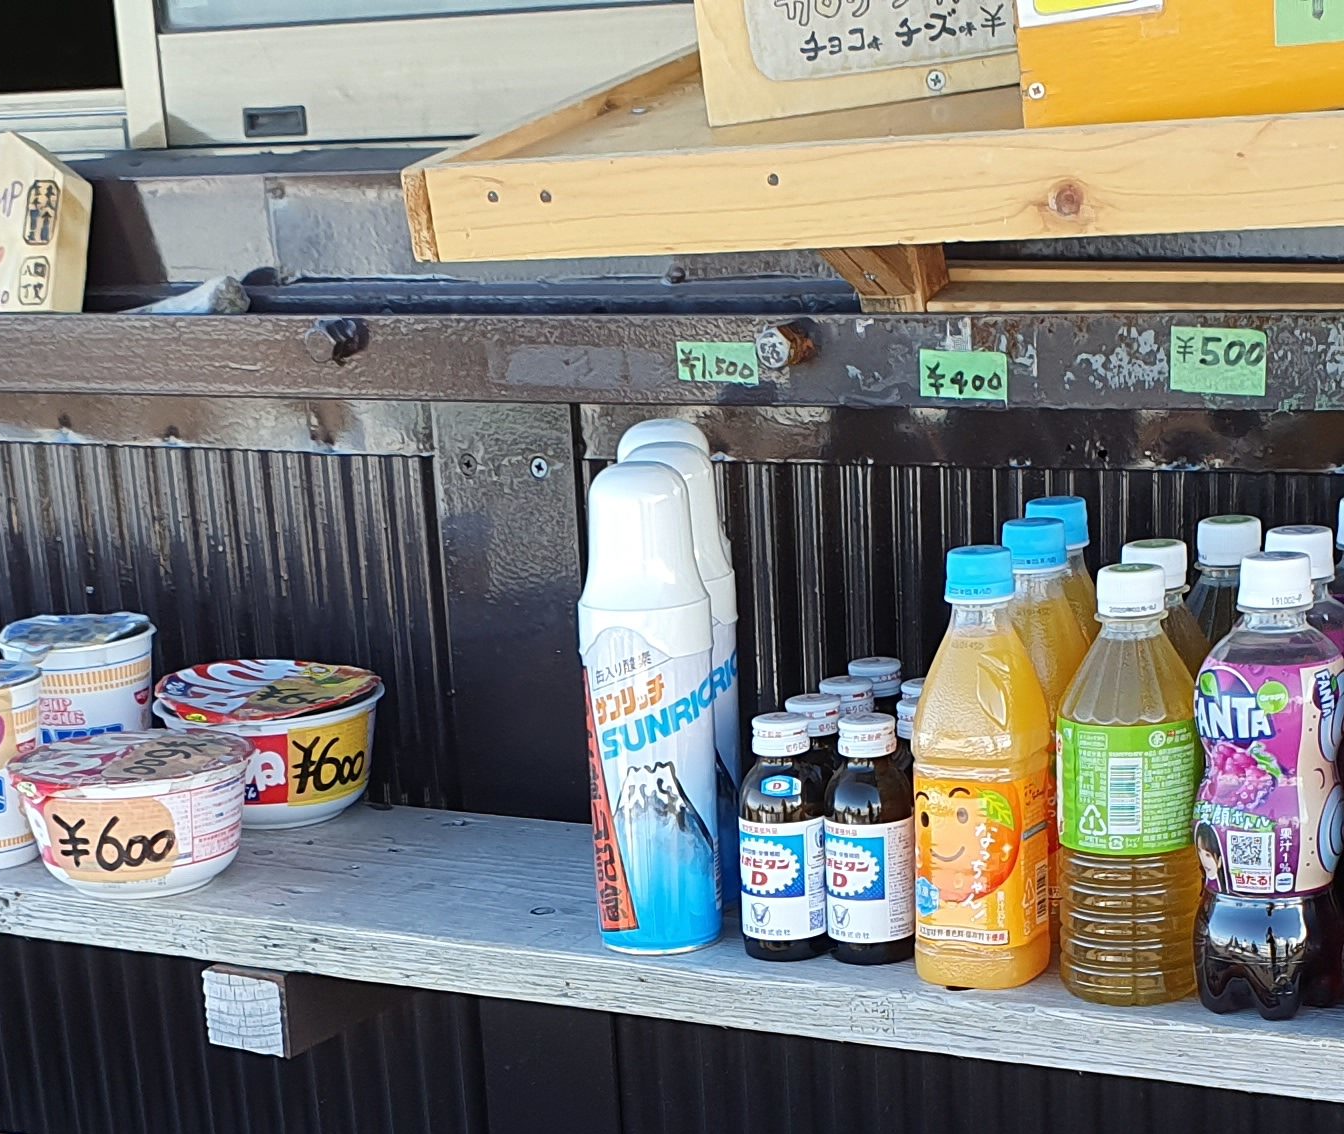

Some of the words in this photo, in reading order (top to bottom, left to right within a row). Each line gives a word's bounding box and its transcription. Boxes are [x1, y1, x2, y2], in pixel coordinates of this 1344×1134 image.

[1175, 334, 1264, 369] ¥500
[926, 361, 1004, 397] ¥400
[1315, 670, 1333, 719] FANTA
[292, 736, 365, 795] ¥600
[52, 813, 176, 872] ¥600
[751, 871, 768, 886] D
[833, 873, 848, 888] D
